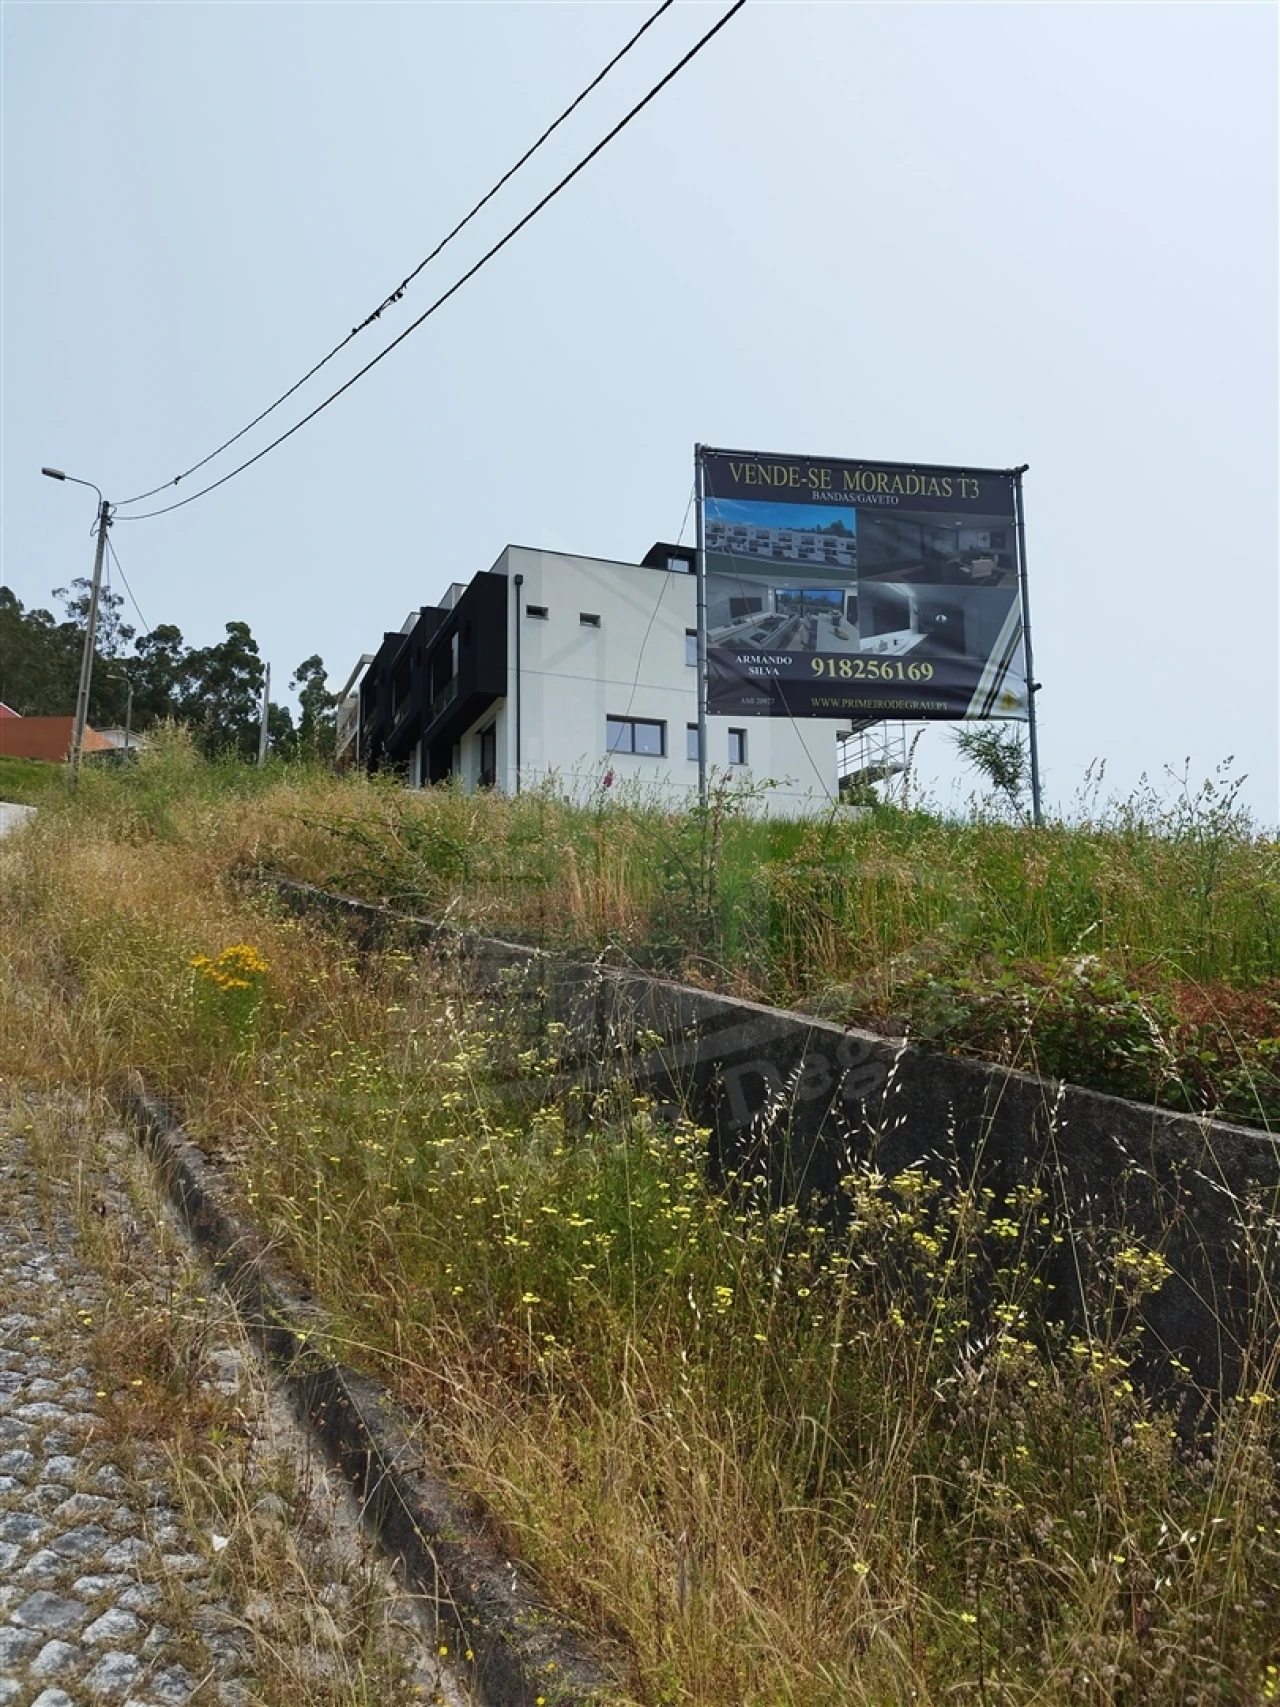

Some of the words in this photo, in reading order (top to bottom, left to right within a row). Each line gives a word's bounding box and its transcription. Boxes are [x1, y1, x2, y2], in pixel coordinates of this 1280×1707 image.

[729, 463, 832, 489] VENDE-SE
[843, 470, 952, 498] MORADIAS
[958, 478, 980, 499] T3
[812, 491, 899, 506] BANDAS/GAVETO
[735, 655, 792, 666] ARMANDO
[748, 667, 779, 677] SILVA
[811, 658, 934, 681] 918256169
